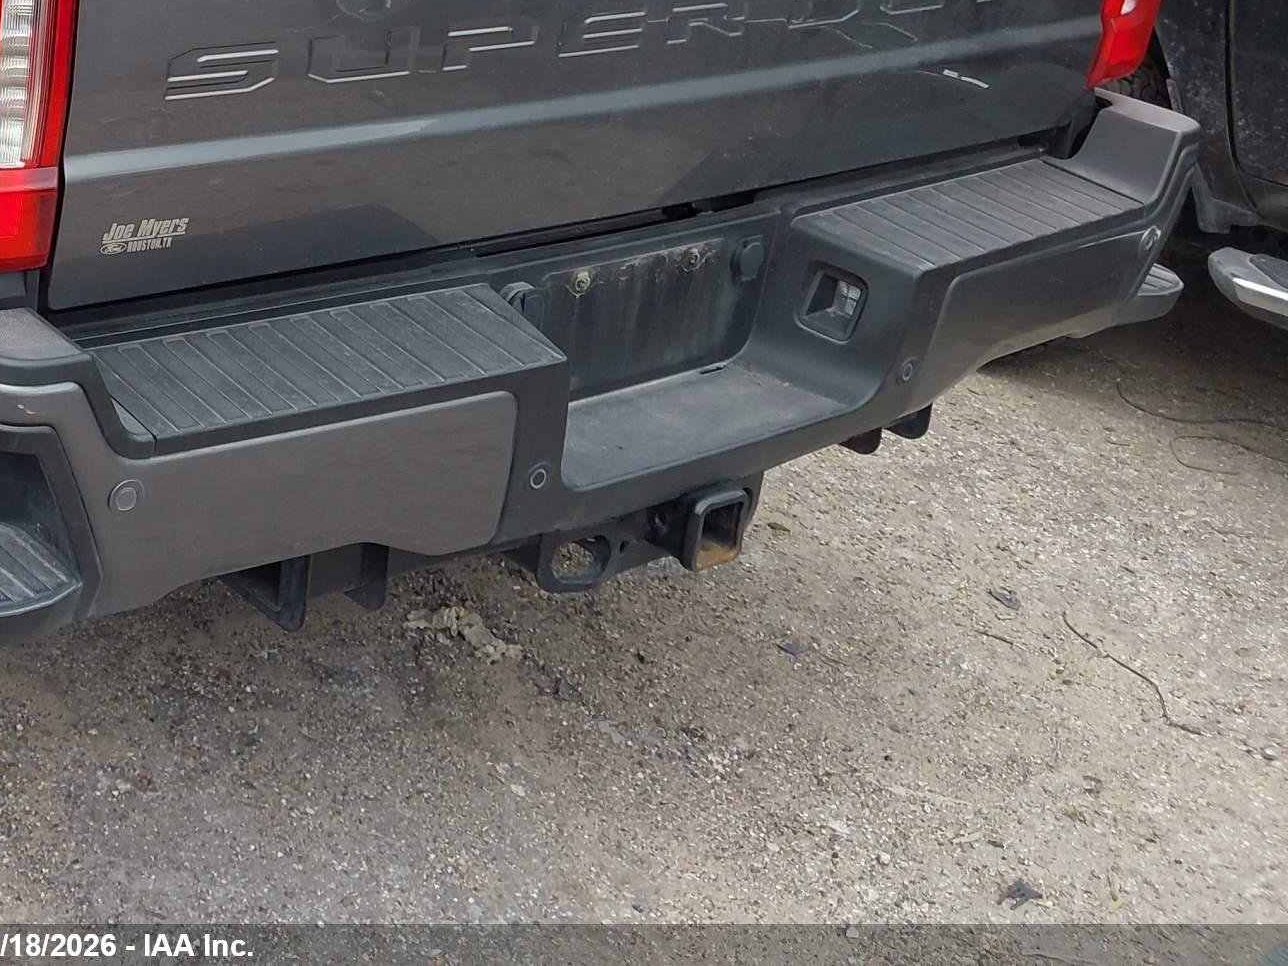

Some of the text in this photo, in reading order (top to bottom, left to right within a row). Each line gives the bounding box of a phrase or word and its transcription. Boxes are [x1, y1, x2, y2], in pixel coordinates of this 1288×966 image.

[163, 1, 743, 101] SUPER
[103, 218, 189, 240] Joe Myers
